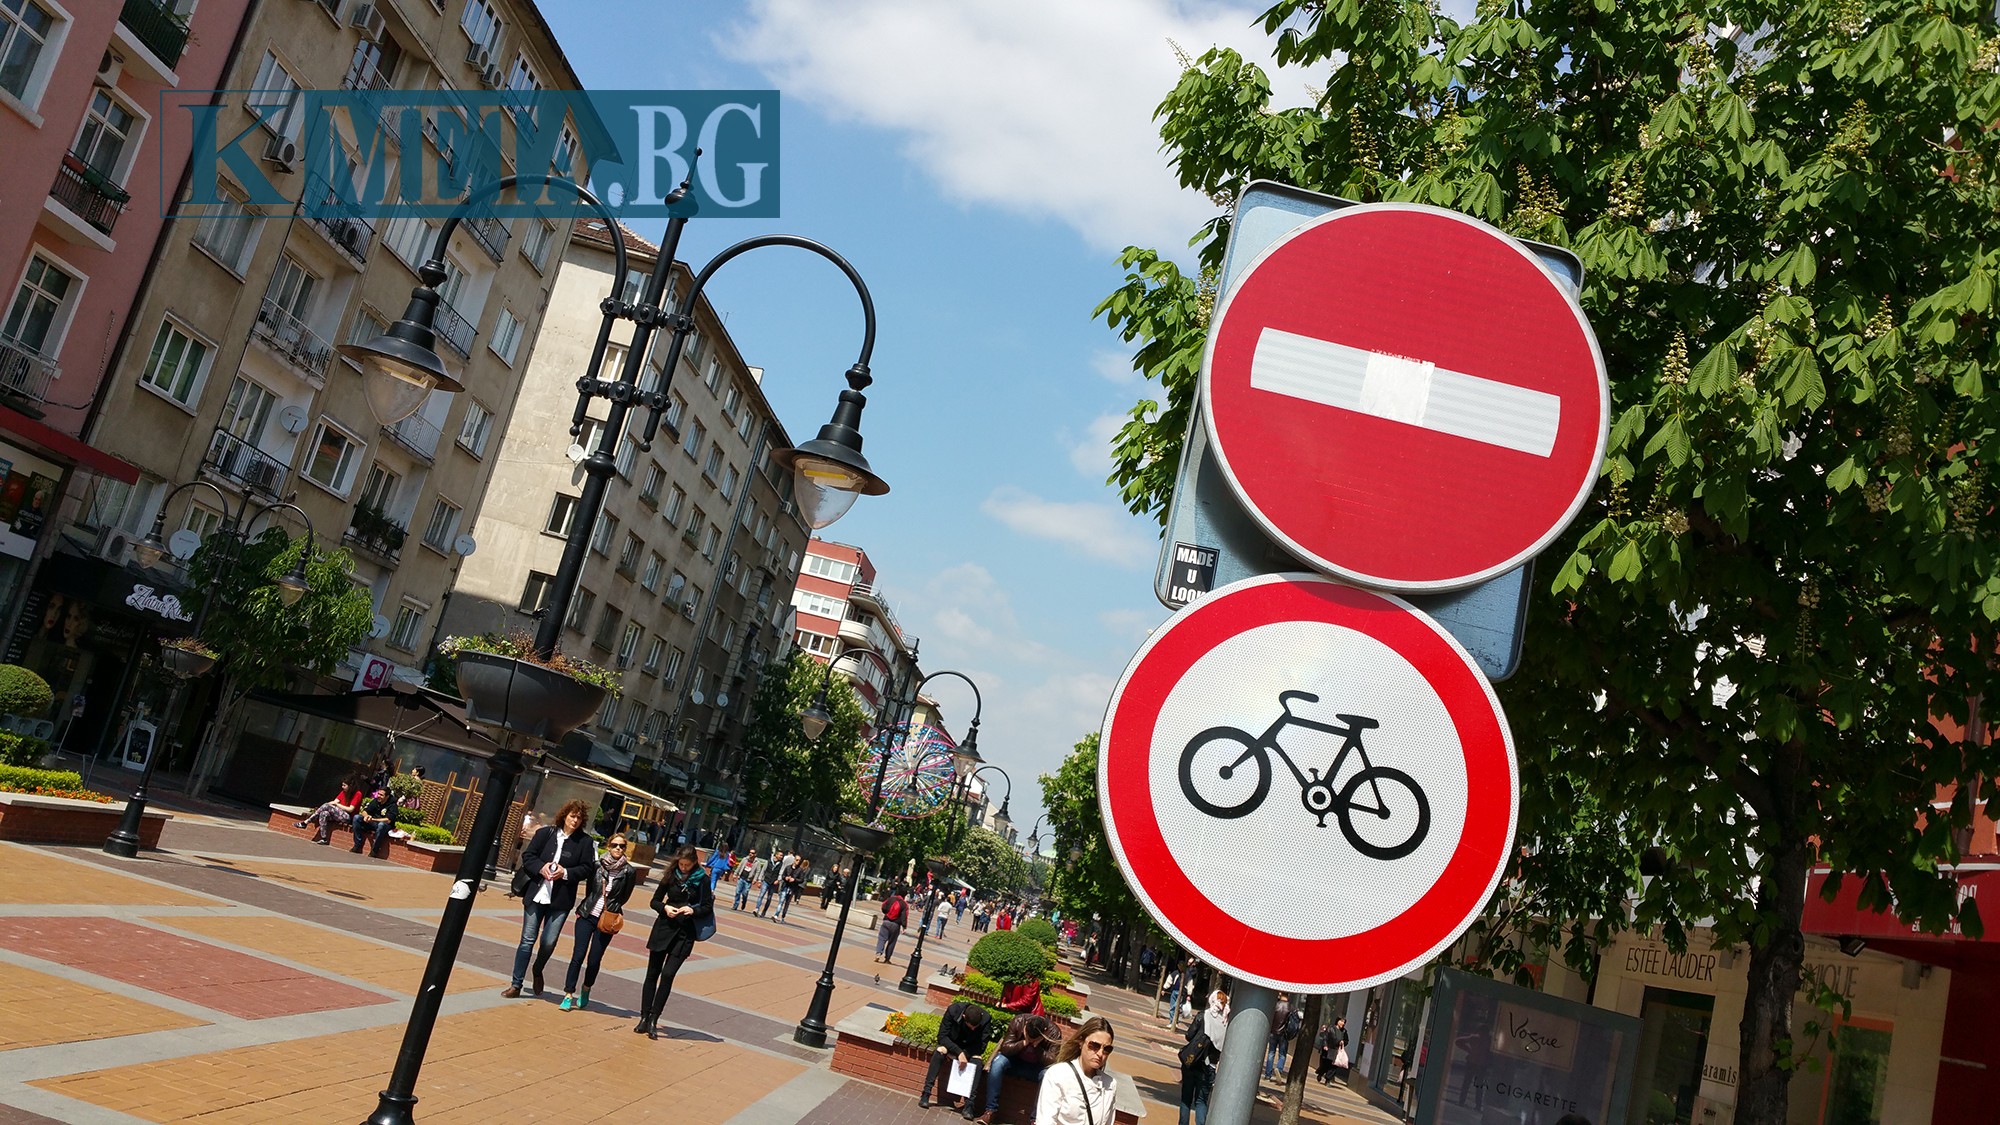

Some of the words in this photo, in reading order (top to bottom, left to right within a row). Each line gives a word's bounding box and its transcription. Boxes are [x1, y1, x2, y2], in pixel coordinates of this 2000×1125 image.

[1176, 547, 1215, 568] MADE
[1186, 568, 1198, 584] U
[1661, 950, 1716, 982] LAUDER
[1509, 1011, 1564, 1053] Vogue
[1702, 1064, 1738, 1084] aramis
[1473, 1076, 1490, 1091] LA
[1496, 1082, 1577, 1114] CIGARETTE
